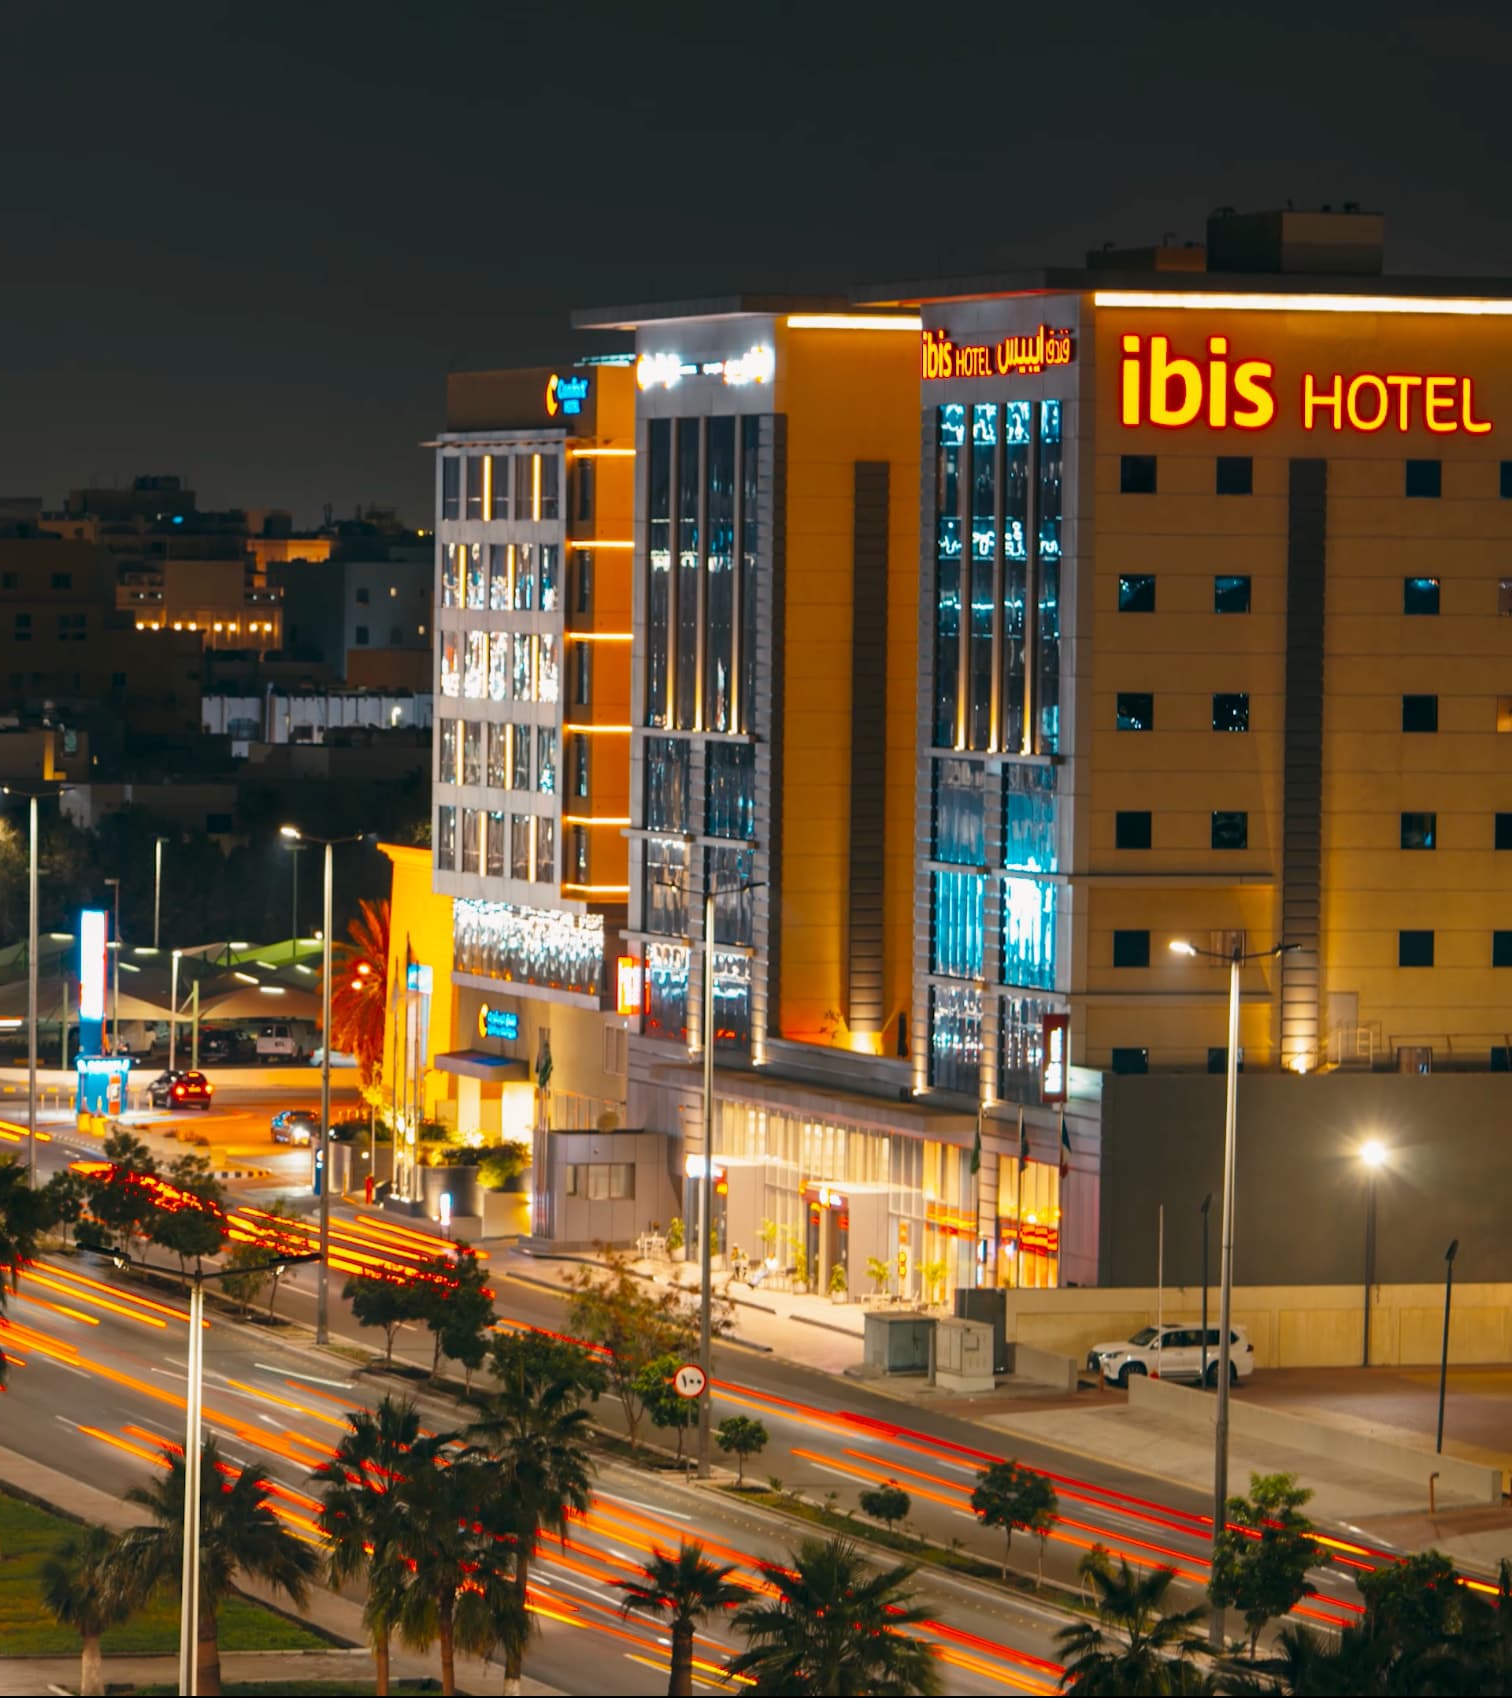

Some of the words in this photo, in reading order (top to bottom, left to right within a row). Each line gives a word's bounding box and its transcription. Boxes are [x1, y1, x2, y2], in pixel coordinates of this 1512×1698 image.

[921, 329, 953, 379] ibis
[955, 345, 993, 377] HOTEL
[1045, 328, 1071, 364] فندق
[1120, 333, 1276, 430] ibis
[1302, 372, 1494, 434] HOTEL
